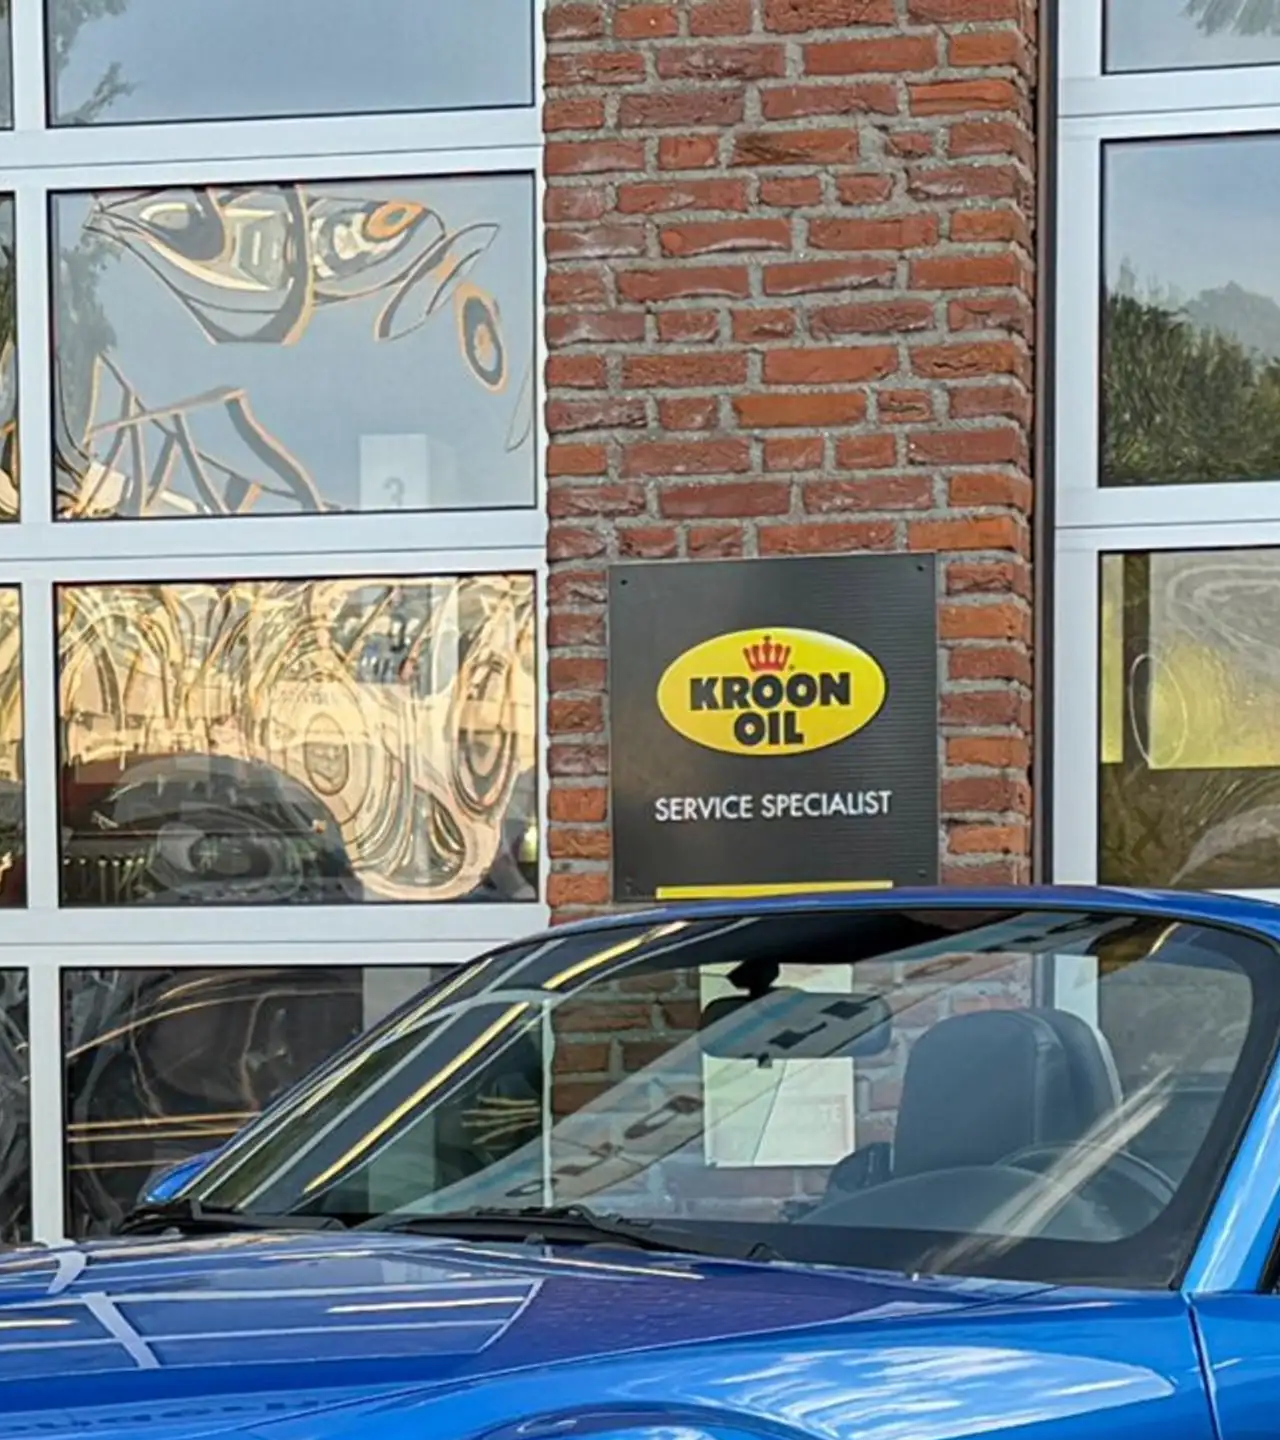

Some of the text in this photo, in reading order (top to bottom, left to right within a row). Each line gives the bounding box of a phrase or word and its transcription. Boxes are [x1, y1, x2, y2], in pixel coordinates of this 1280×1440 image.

[689, 672, 851, 711] KROON
[733, 711, 805, 746] OIL
[654, 790, 892, 822] SERVICE SPECIALIST
